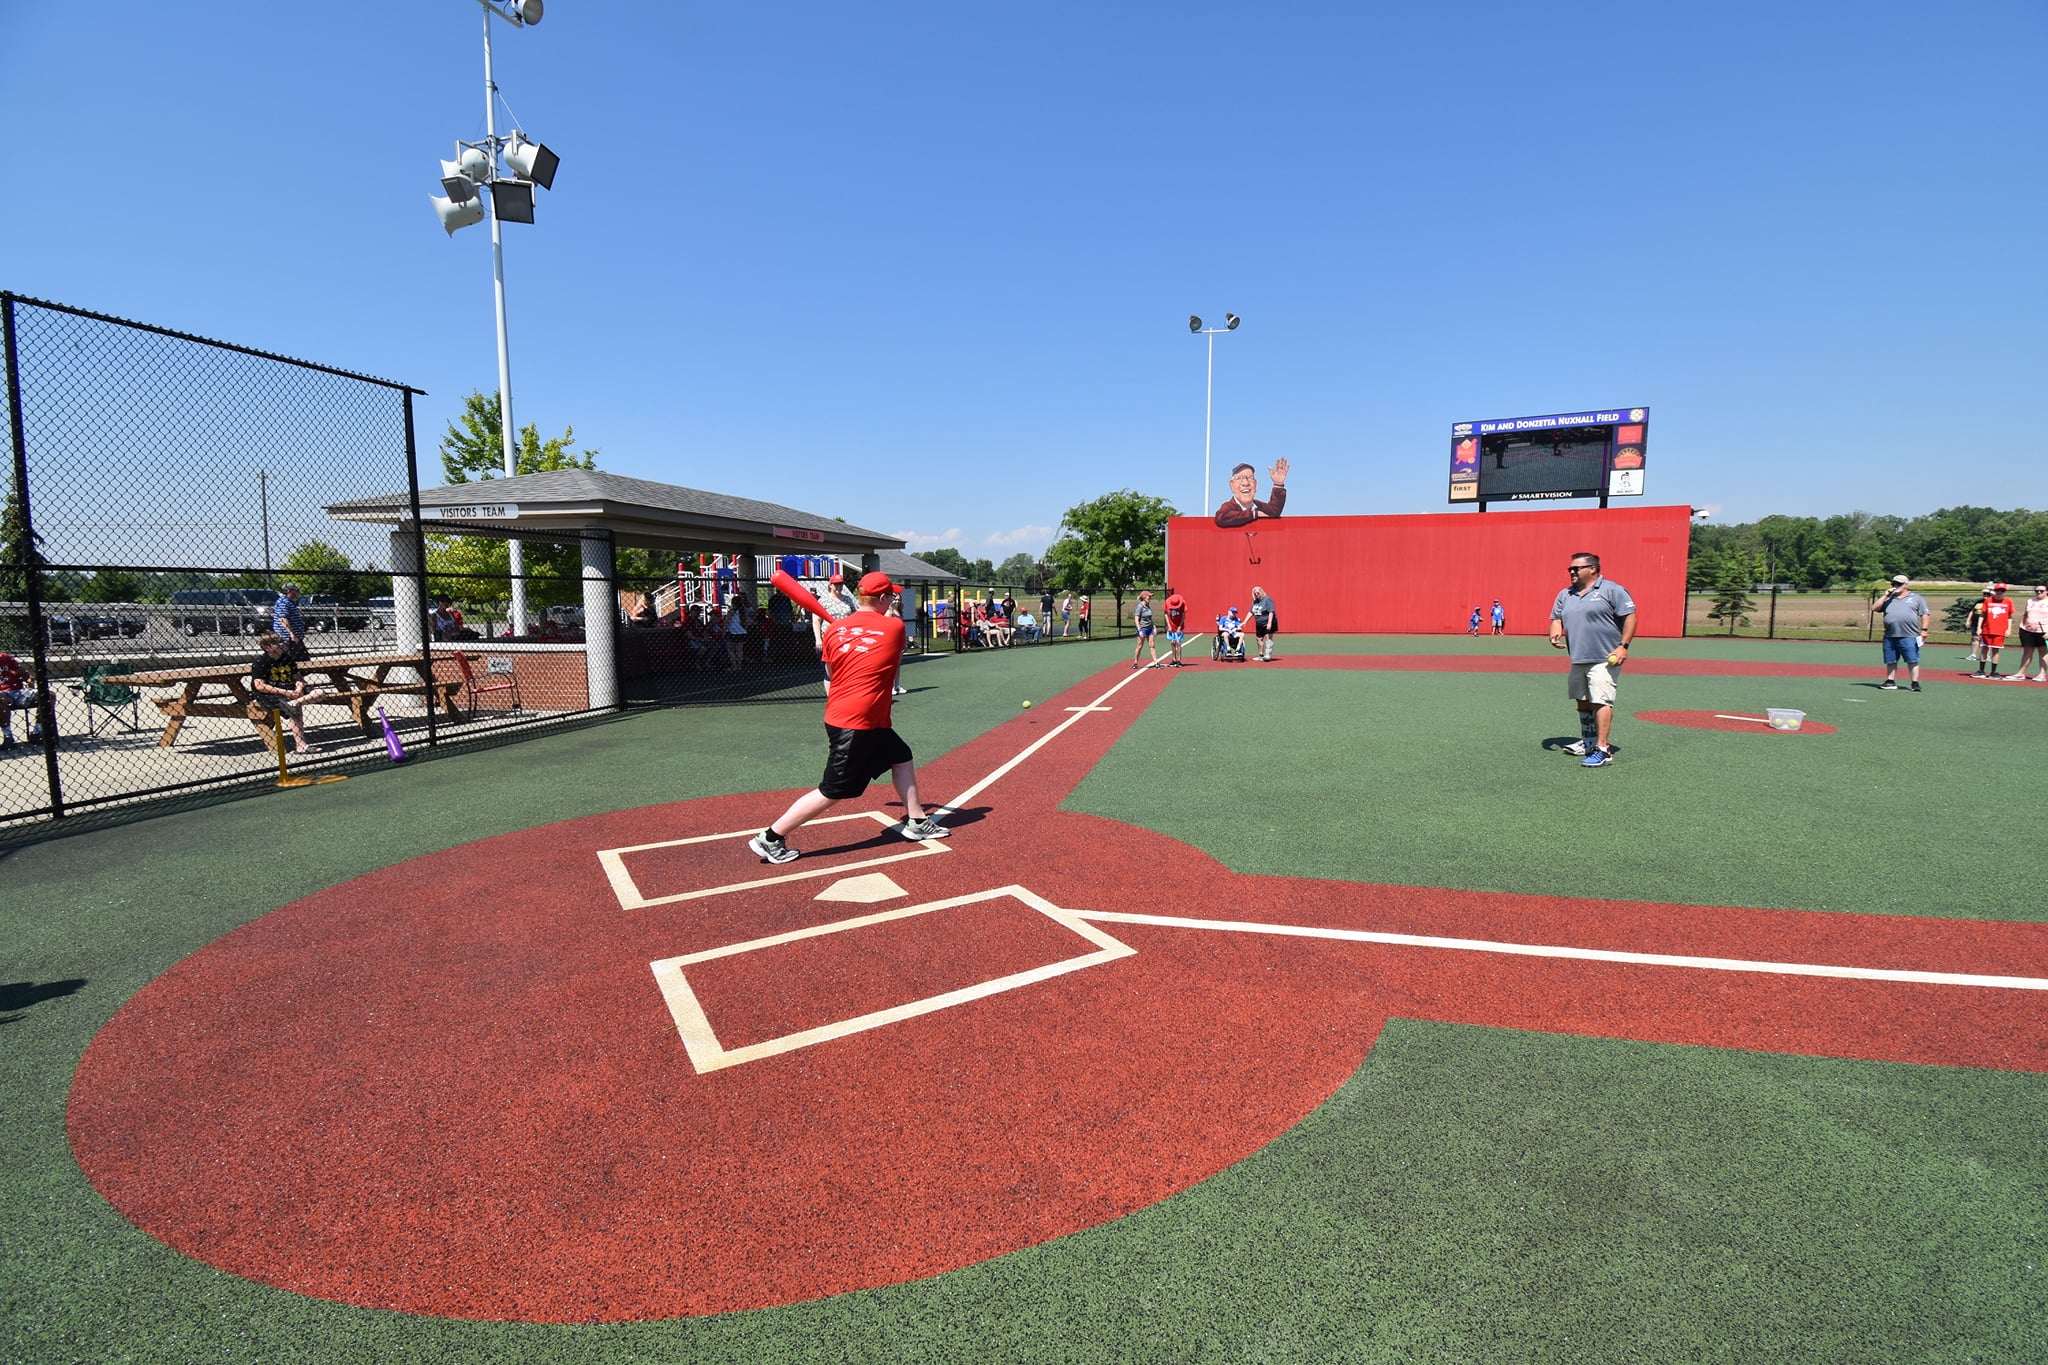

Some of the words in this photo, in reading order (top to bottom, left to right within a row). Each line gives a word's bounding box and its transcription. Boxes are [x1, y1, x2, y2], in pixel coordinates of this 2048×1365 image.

[1481, 423, 1496, 432] KIM
[1497, 421, 1514, 431] AND
[1516, 418, 1557, 429] DONZETTA
[1558, 415, 1595, 426] NUXHALL
[1597, 413, 1620, 422] FIELD
[440, 507, 477, 518] VISITORS
[482, 506, 506, 517] TEAM
